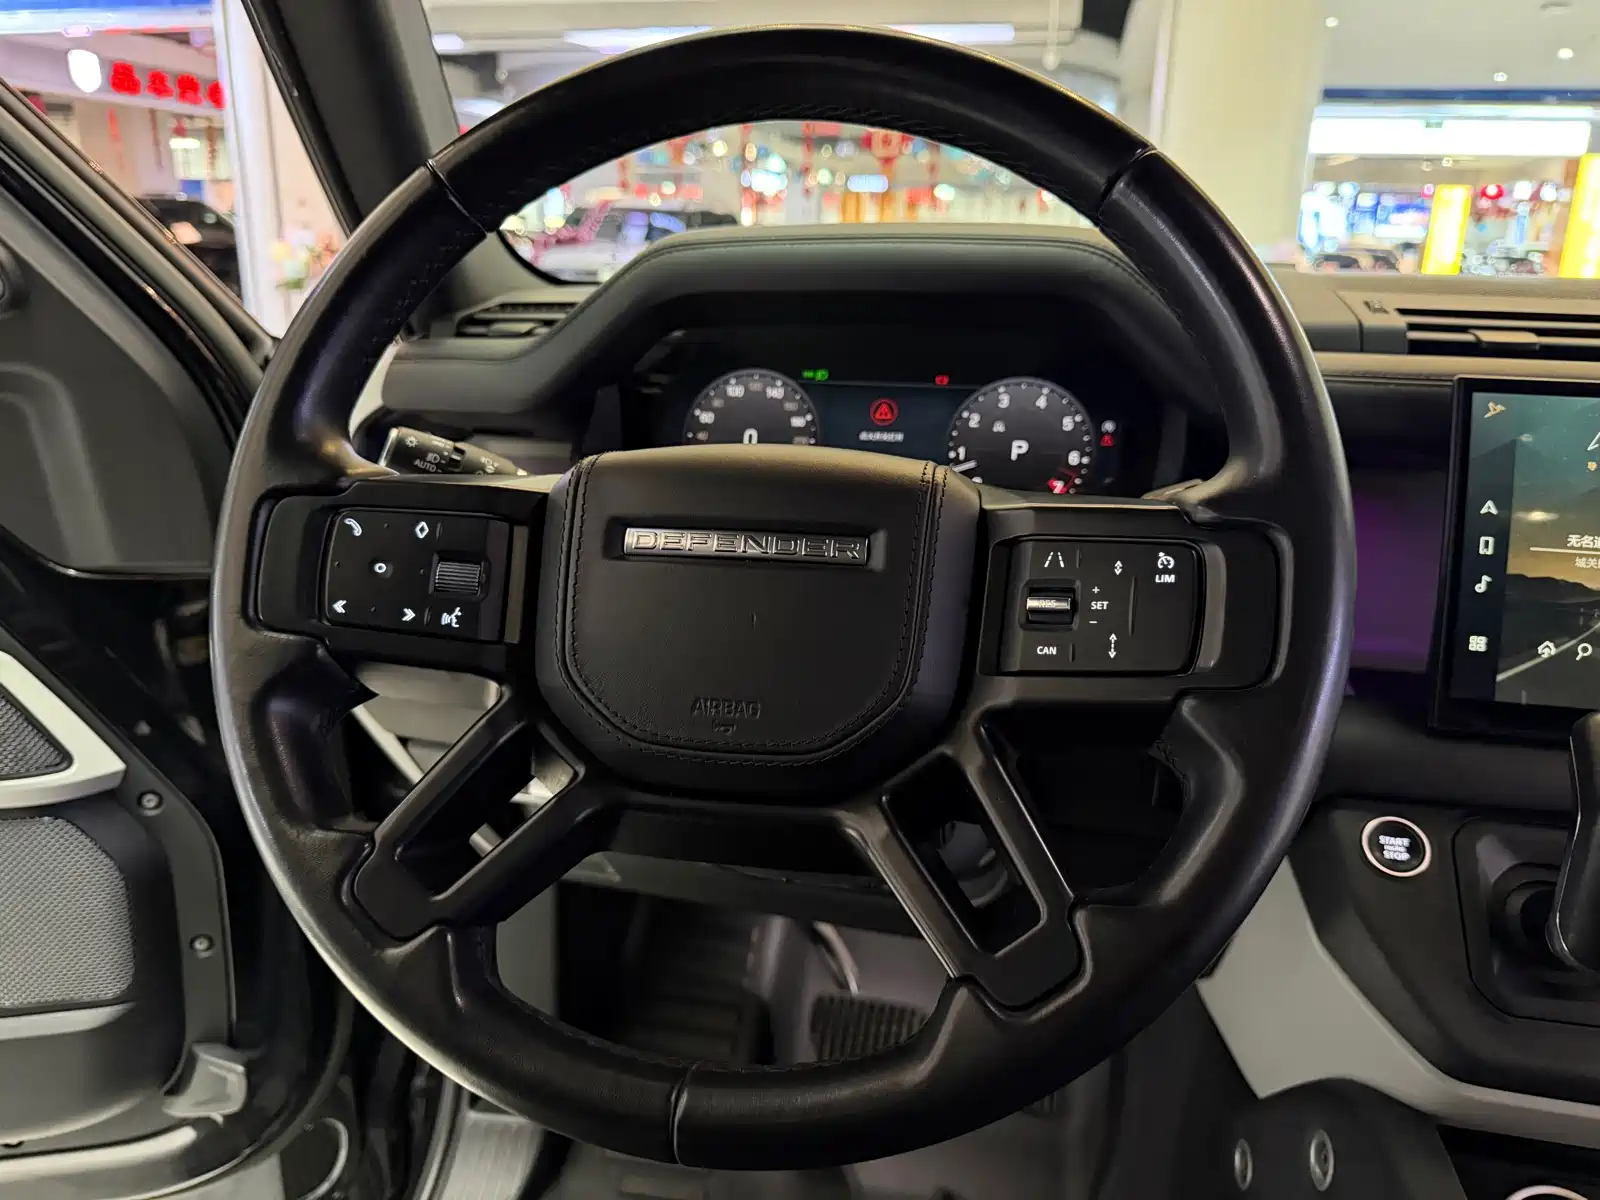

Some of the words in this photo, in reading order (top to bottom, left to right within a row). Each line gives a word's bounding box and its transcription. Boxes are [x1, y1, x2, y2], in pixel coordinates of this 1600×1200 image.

[998, 392, 1010, 408] 3
[1035, 394, 1048, 410] 4
[968, 412, 981, 428] 2
[1062, 415, 1075, 432] 5
[957, 445, 966, 461] 1
[1010, 439, 1030, 462] P
[413, 458, 437, 473] AUTO
[633, 531, 861, 559] DEFENDER
[1155, 574, 1176, 583] LIM
[1090, 601, 1109, 610] SET
[1036, 645, 1057, 655] CAN
[691, 697, 761, 719] AIRBAG
[1378, 835, 1411, 847] START
[1382, 850, 1411, 861] STOP
